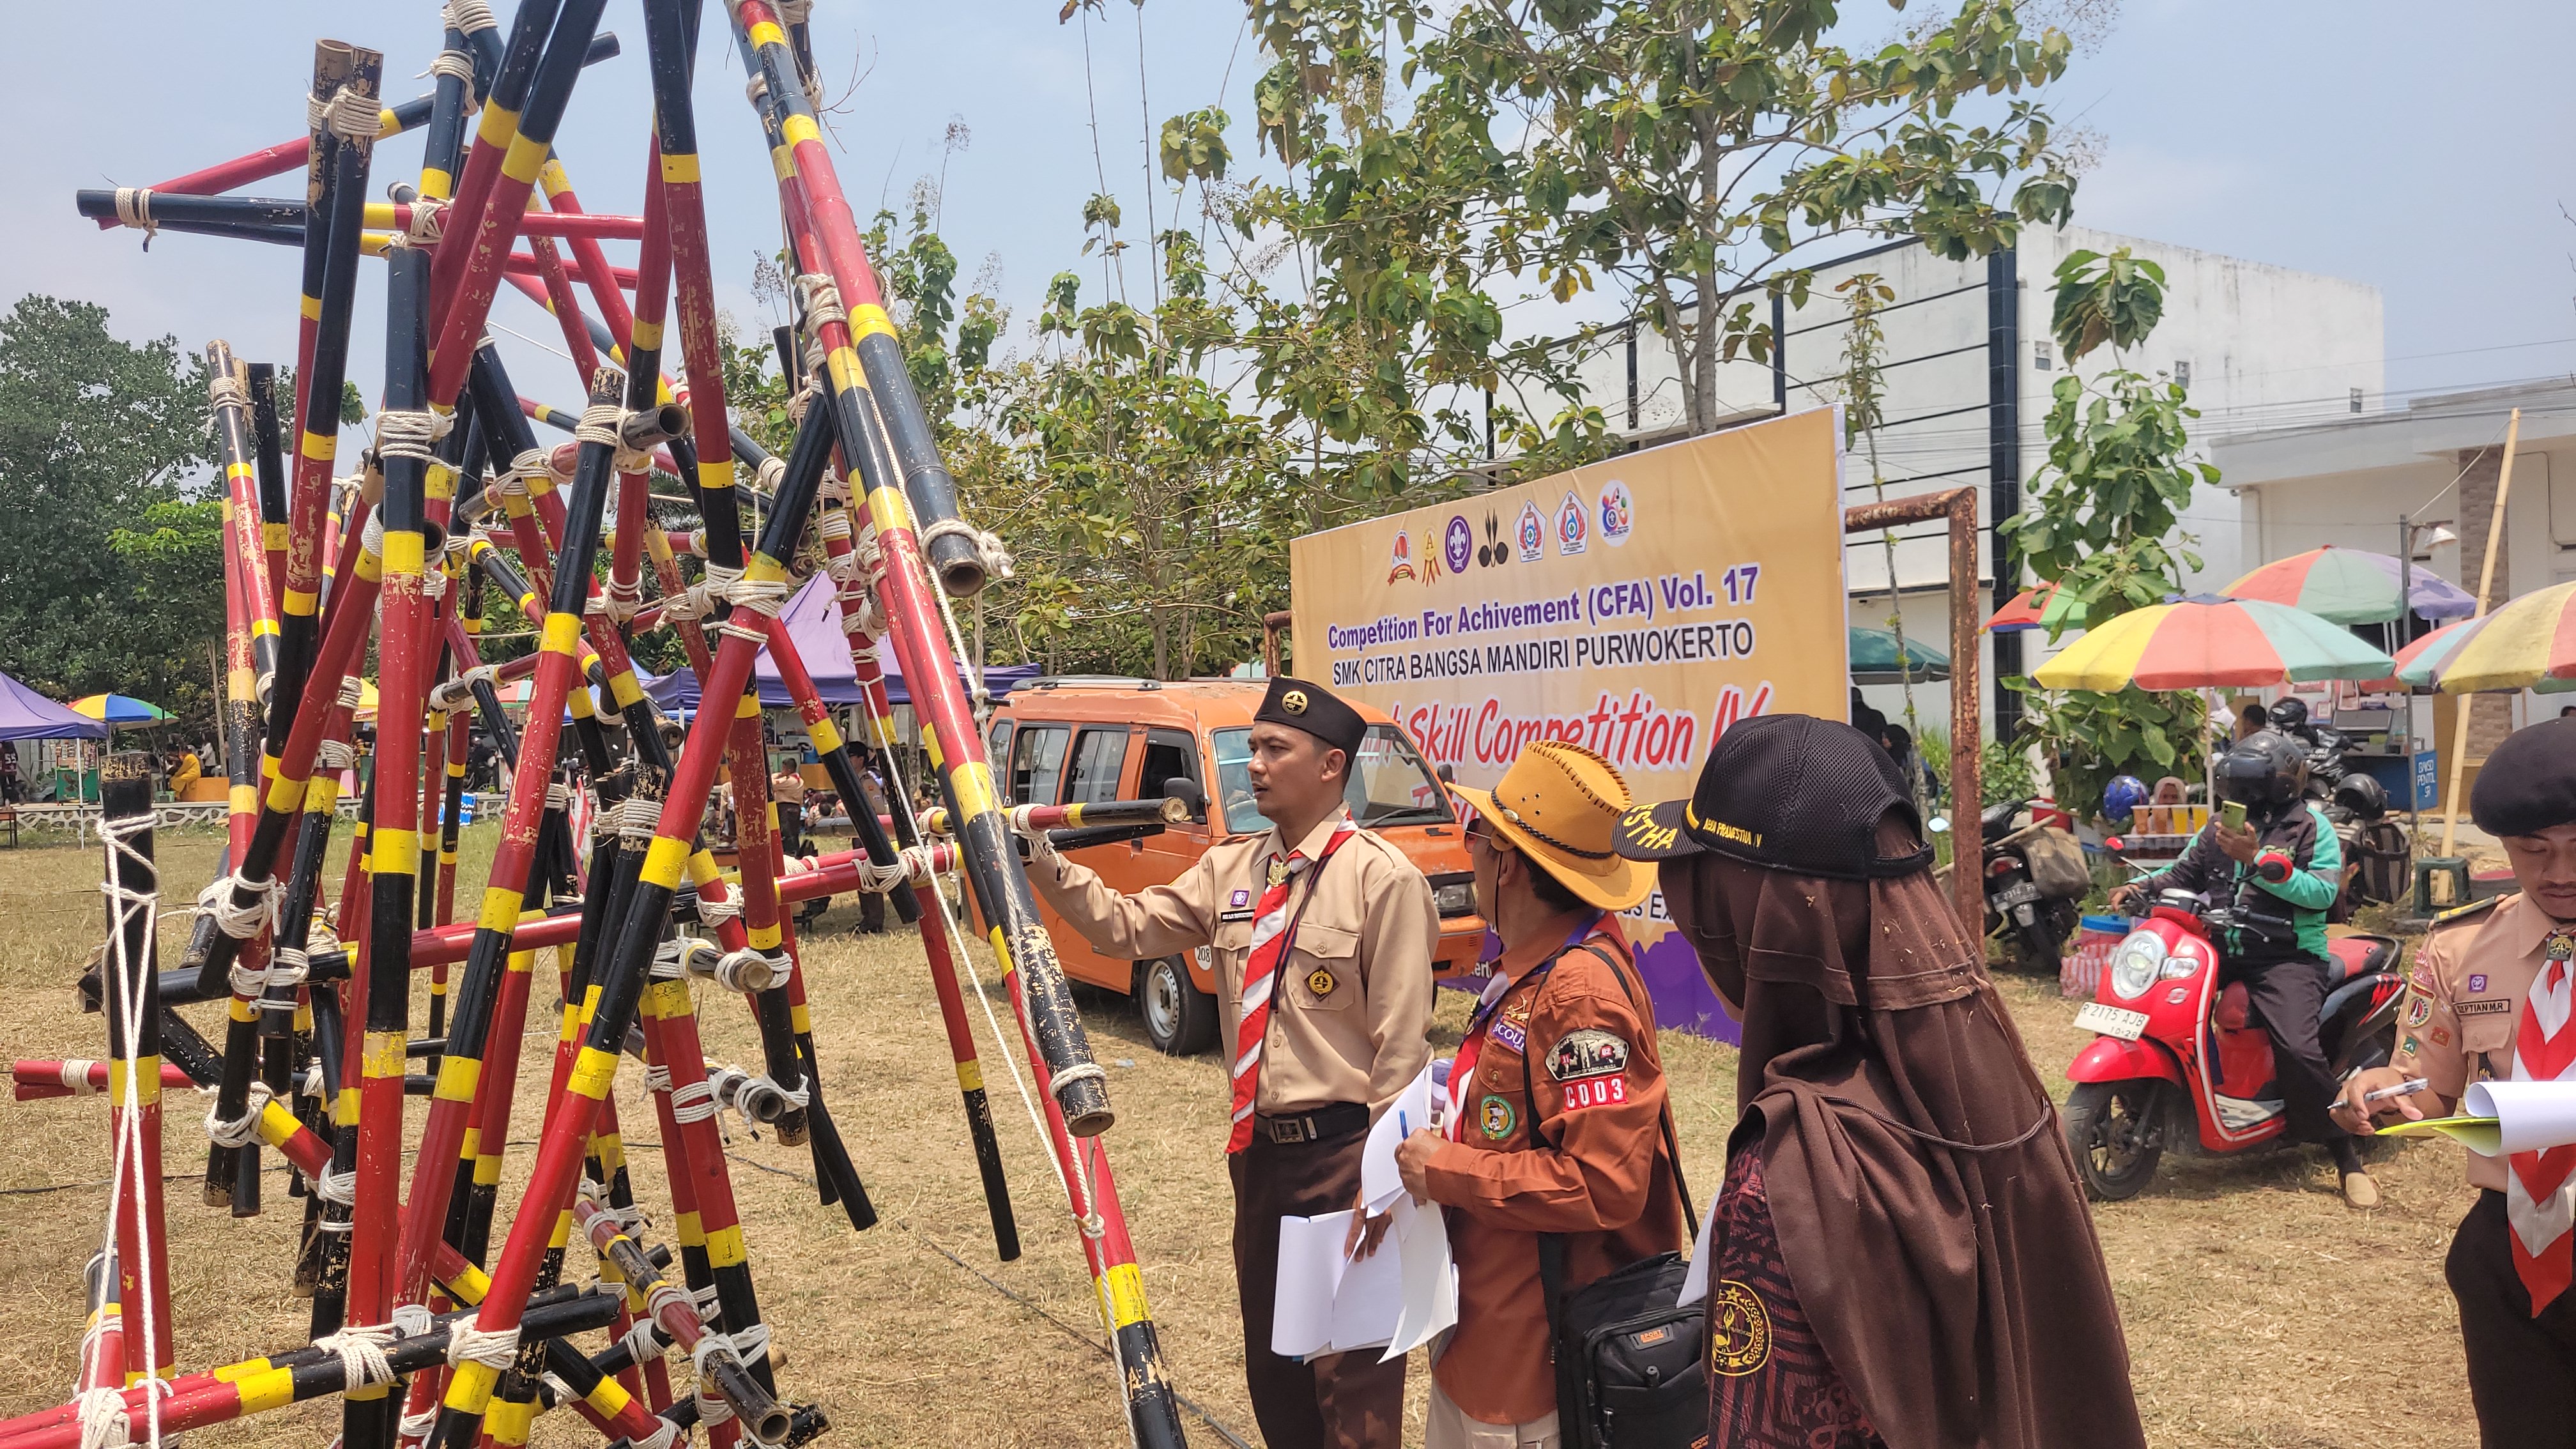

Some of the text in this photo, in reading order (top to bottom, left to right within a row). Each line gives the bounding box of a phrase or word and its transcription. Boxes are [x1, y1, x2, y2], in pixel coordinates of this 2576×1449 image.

[1328, 567, 1758, 651] Competition For Achivement (CFA) Vol. 17
[1333, 622, 1753, 686] SMK CITRA BANGSA MANDIRI PURWOKERTO
[1409, 703, 1471, 763] Skill
[1475, 693, 1693, 765] Competition
[1197, 947, 1211, 963] 208
[2082, 1004, 2145, 1027] R 2175 AJB
